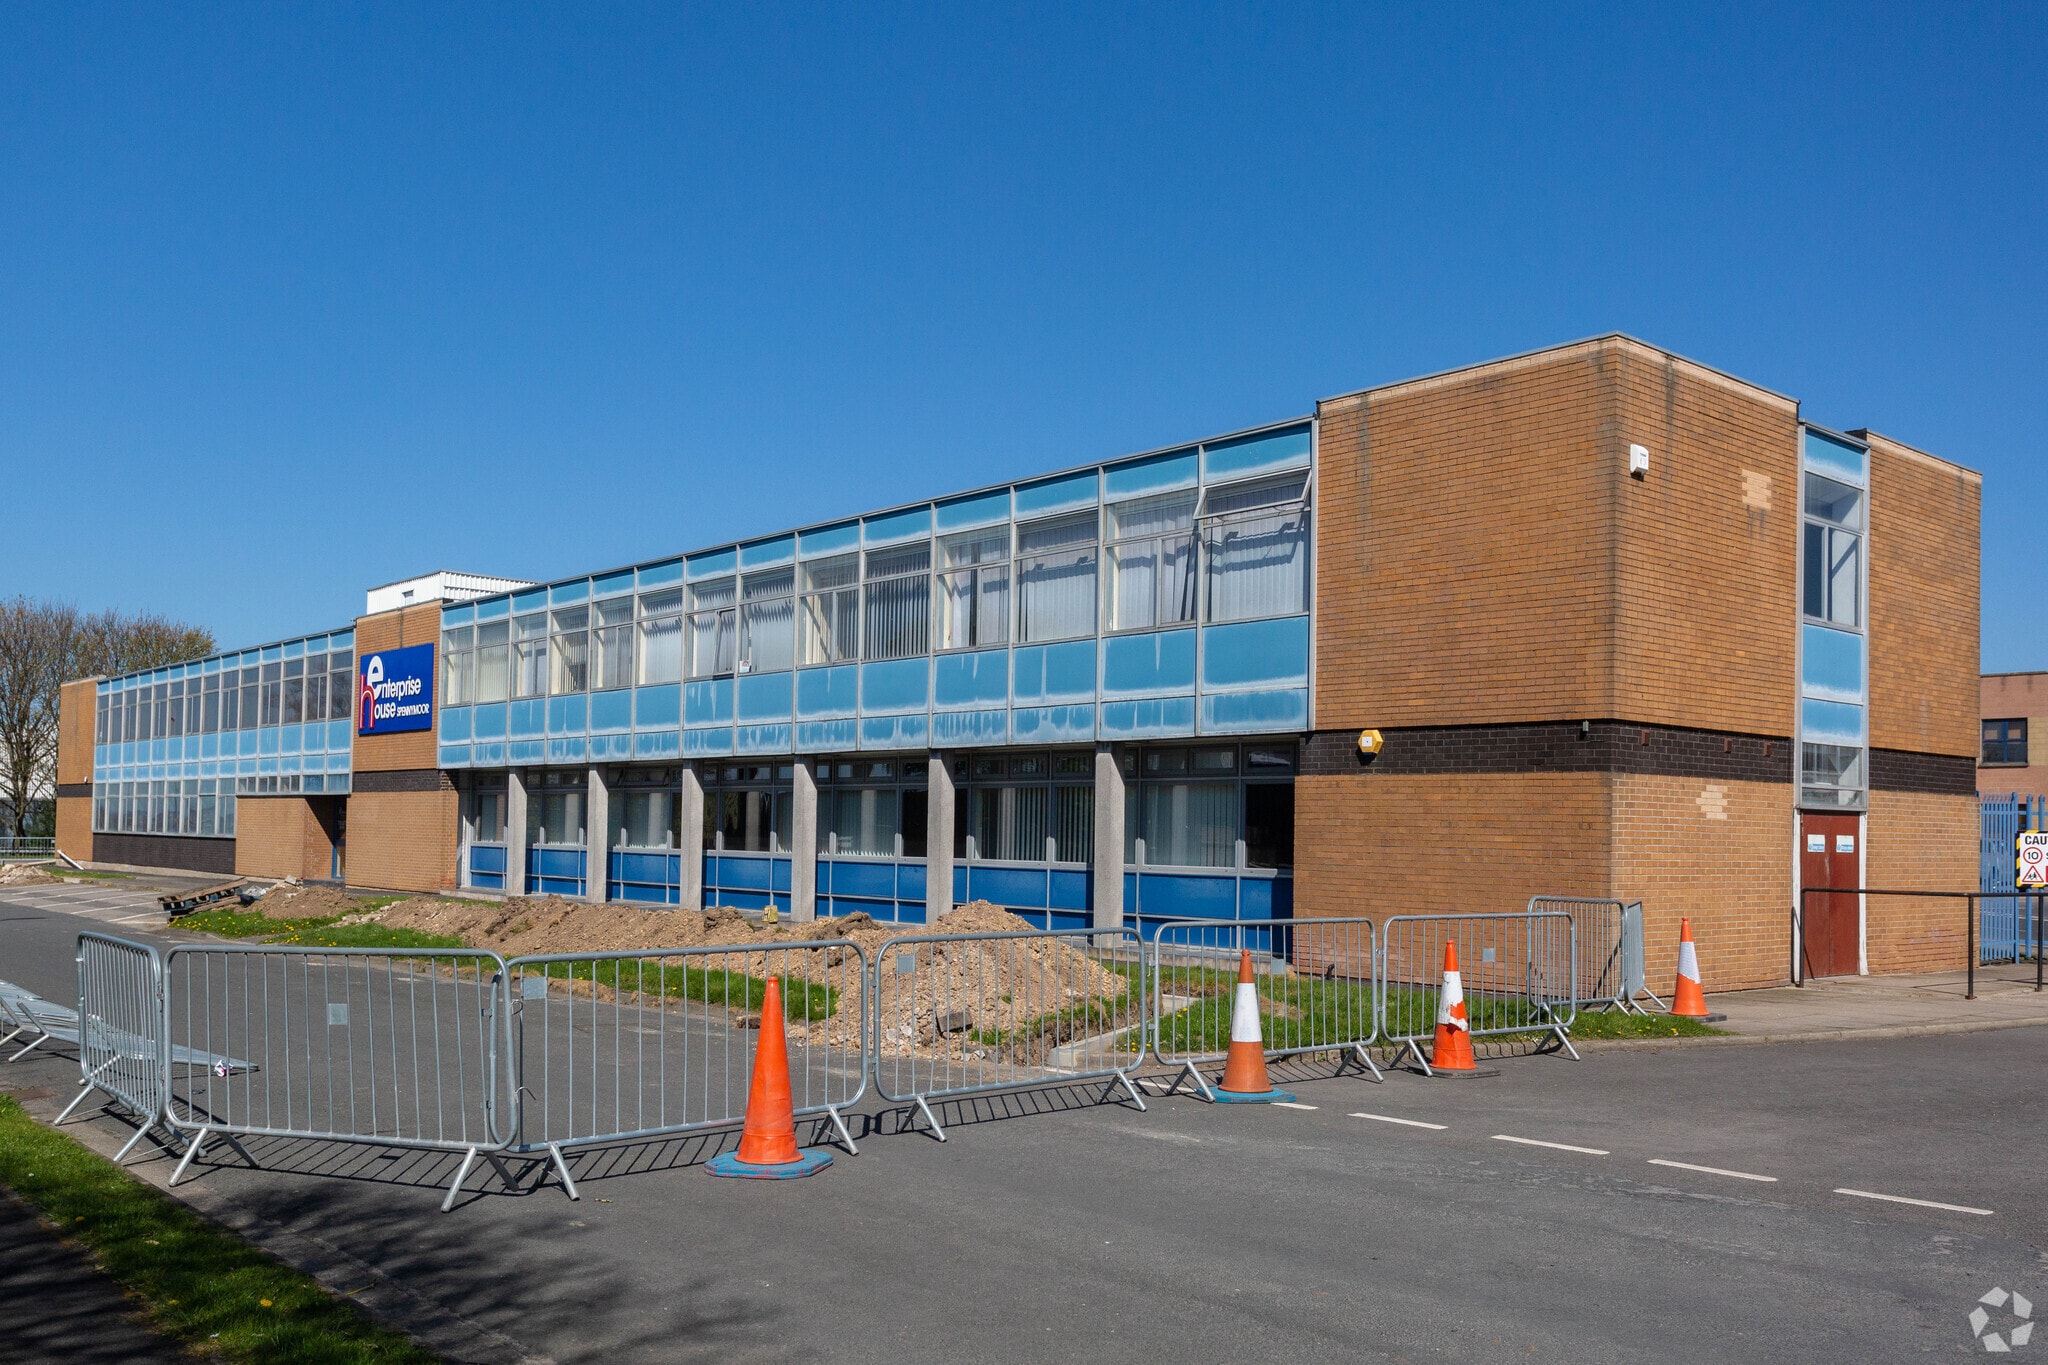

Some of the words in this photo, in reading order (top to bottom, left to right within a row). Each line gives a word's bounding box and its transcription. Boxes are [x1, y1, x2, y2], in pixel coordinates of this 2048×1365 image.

[367, 655, 421, 701] enterprise
[359, 674, 396, 729] house
[2025, 835, 2048, 845] CAU
[2027, 851, 2039, 860] 10
